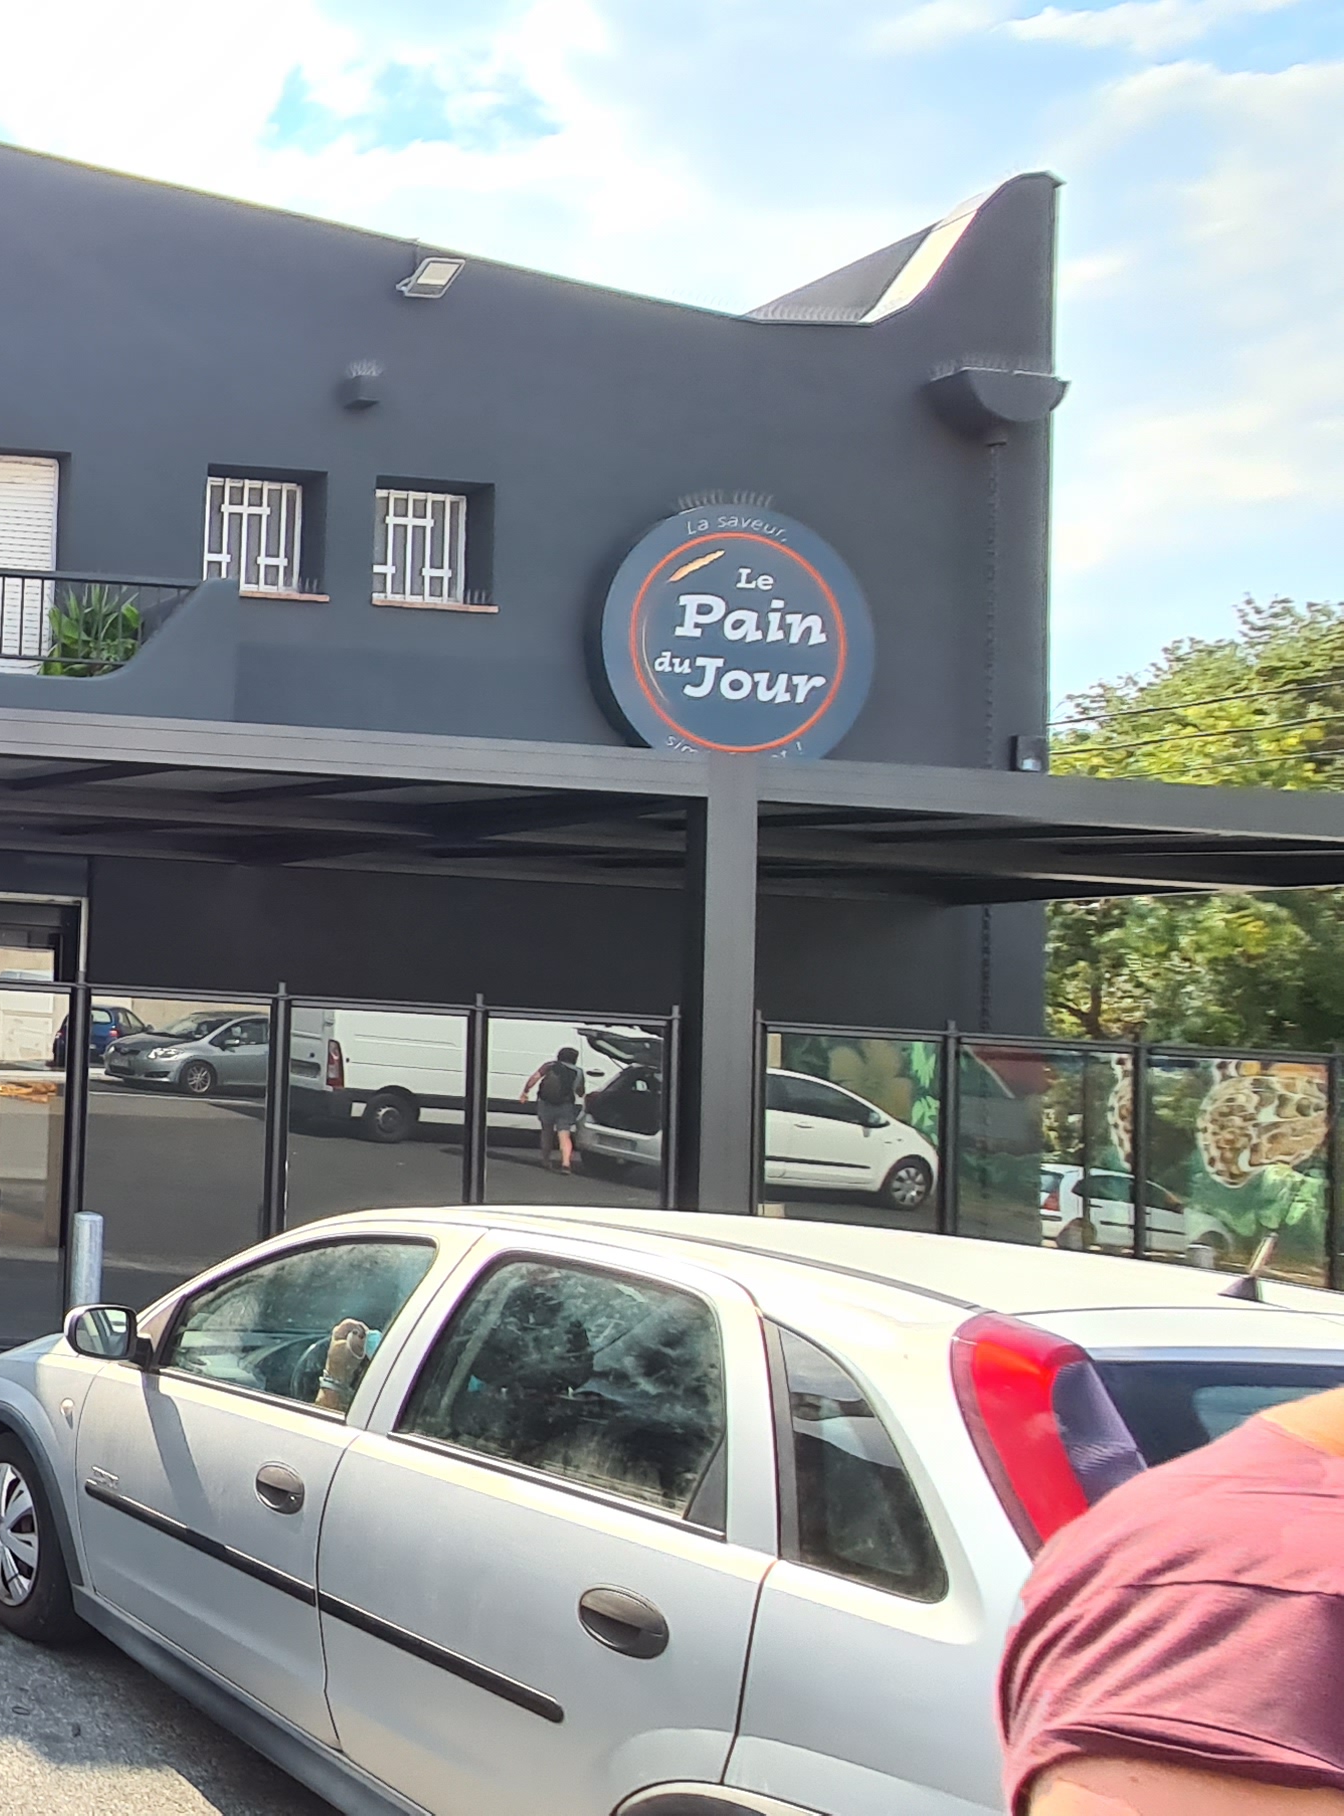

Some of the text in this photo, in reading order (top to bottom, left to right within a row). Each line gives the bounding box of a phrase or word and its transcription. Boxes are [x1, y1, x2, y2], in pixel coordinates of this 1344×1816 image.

[686, 518, 710, 535] La
[736, 567, 775, 591] Le
[674, 593, 827, 646] Pain
[653, 651, 827, 704] du Jour
